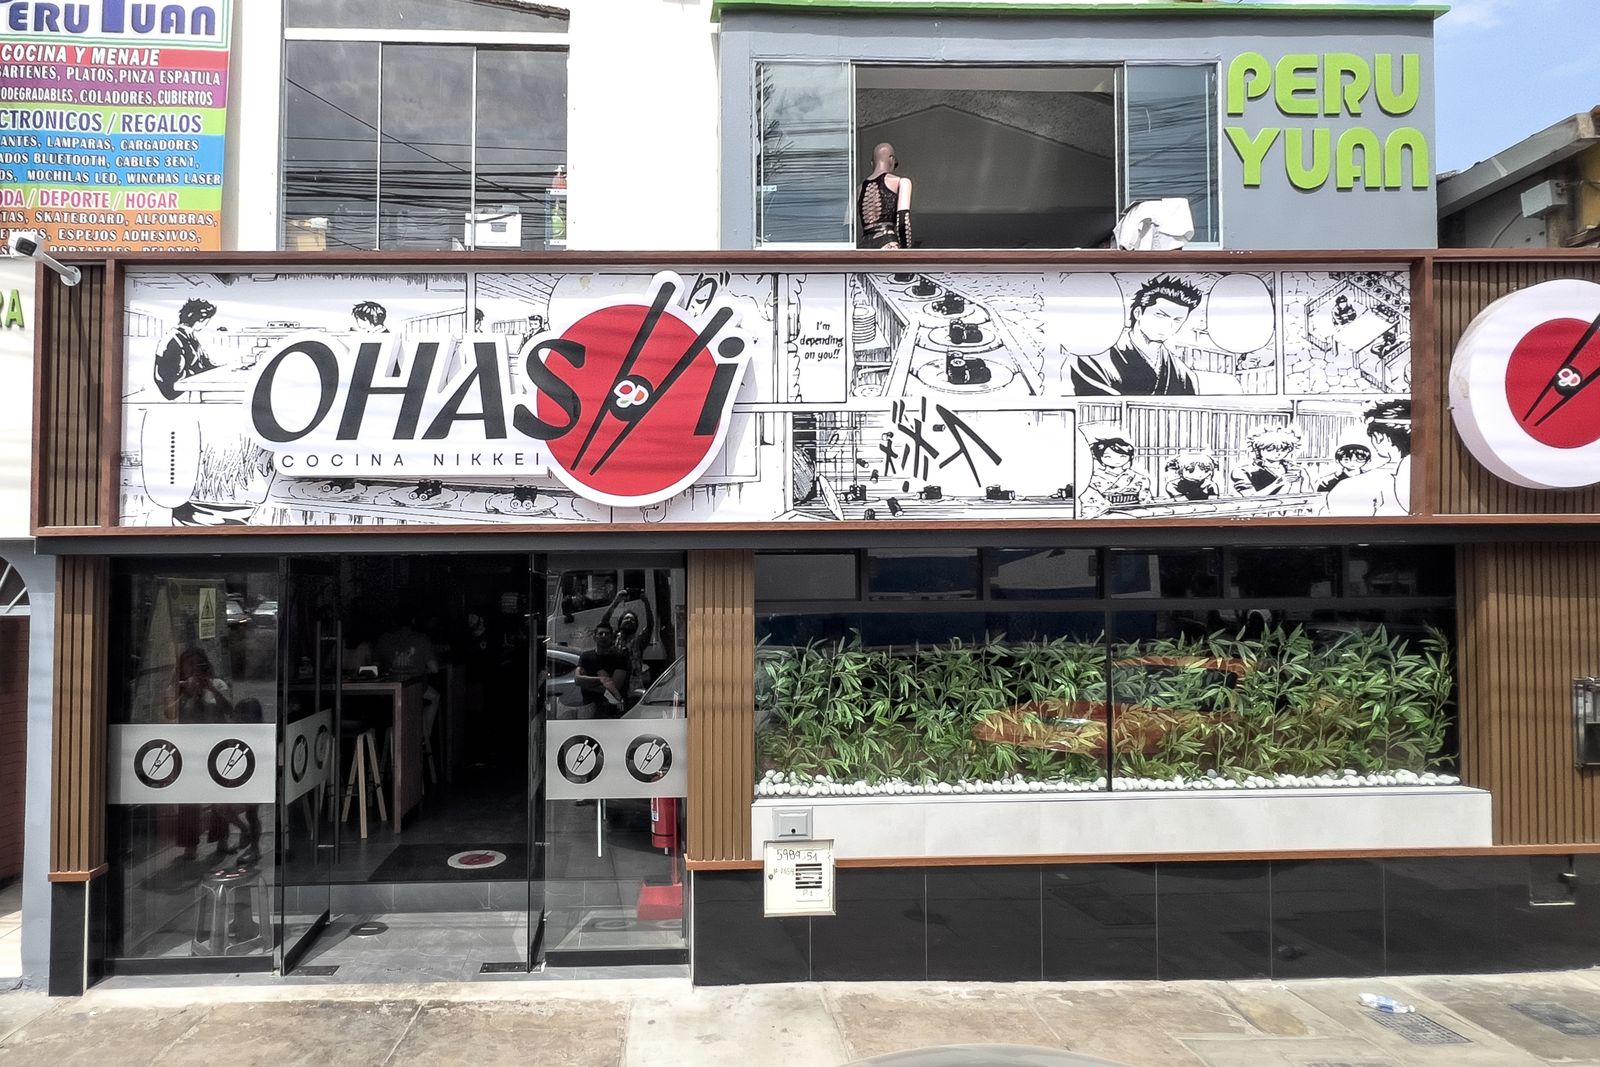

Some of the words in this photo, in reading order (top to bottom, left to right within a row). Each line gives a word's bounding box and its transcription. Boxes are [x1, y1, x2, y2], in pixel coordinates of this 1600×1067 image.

[0, 0, 89, 33] ERU
[2, 44, 67, 63] COCINA
[75, 47, 87, 64] Y
[91, 48, 160, 66] MENAJE
[0, 65, 61, 81] ARTENES,
[119, 69, 155, 84] PINZA
[160, 70, 221, 85] ESPATULA
[1227, 51, 1420, 117] PERU
[80, 89, 157, 105] COLADORES,
[158, 90, 213, 106] CUBIERTOS
[122, 114, 202, 133] REGALOS
[46, 136, 115, 152] LAMPARAS,
[120, 139, 199, 151] CARGADORES
[33, 153, 111, 168] BLUETOOTH,
[115, 155, 160, 167] CABLES
[164, 155, 200, 169] 3EN1,
[1224, 126, 1430, 191] YUAN
[27, 170, 90, 183] MOCHILAS
[94, 172, 121, 185] LED,
[126, 172, 179, 184] WINCHAS
[184, 172, 222, 185] LASER
[0, 189, 24, 206] DA
[40, 190, 109, 208] DEPORTE
[126, 192, 178, 209] HOGAR
[35, 211, 129, 226] SKATEBOARD,
[135, 213, 218, 227] ALFOMBRAS,
[58, 228, 118, 241] ESPEJOS
[122, 230, 202, 243] ADHESIVOS,
[0, 287, 25, 329] A
[799, 334, 844, 348] depending
[804, 351, 816, 360] on
[817, 348, 841, 362] you!!
[281, 453, 404, 468] COCINA
[433, 451, 540, 467] NIKKEI
